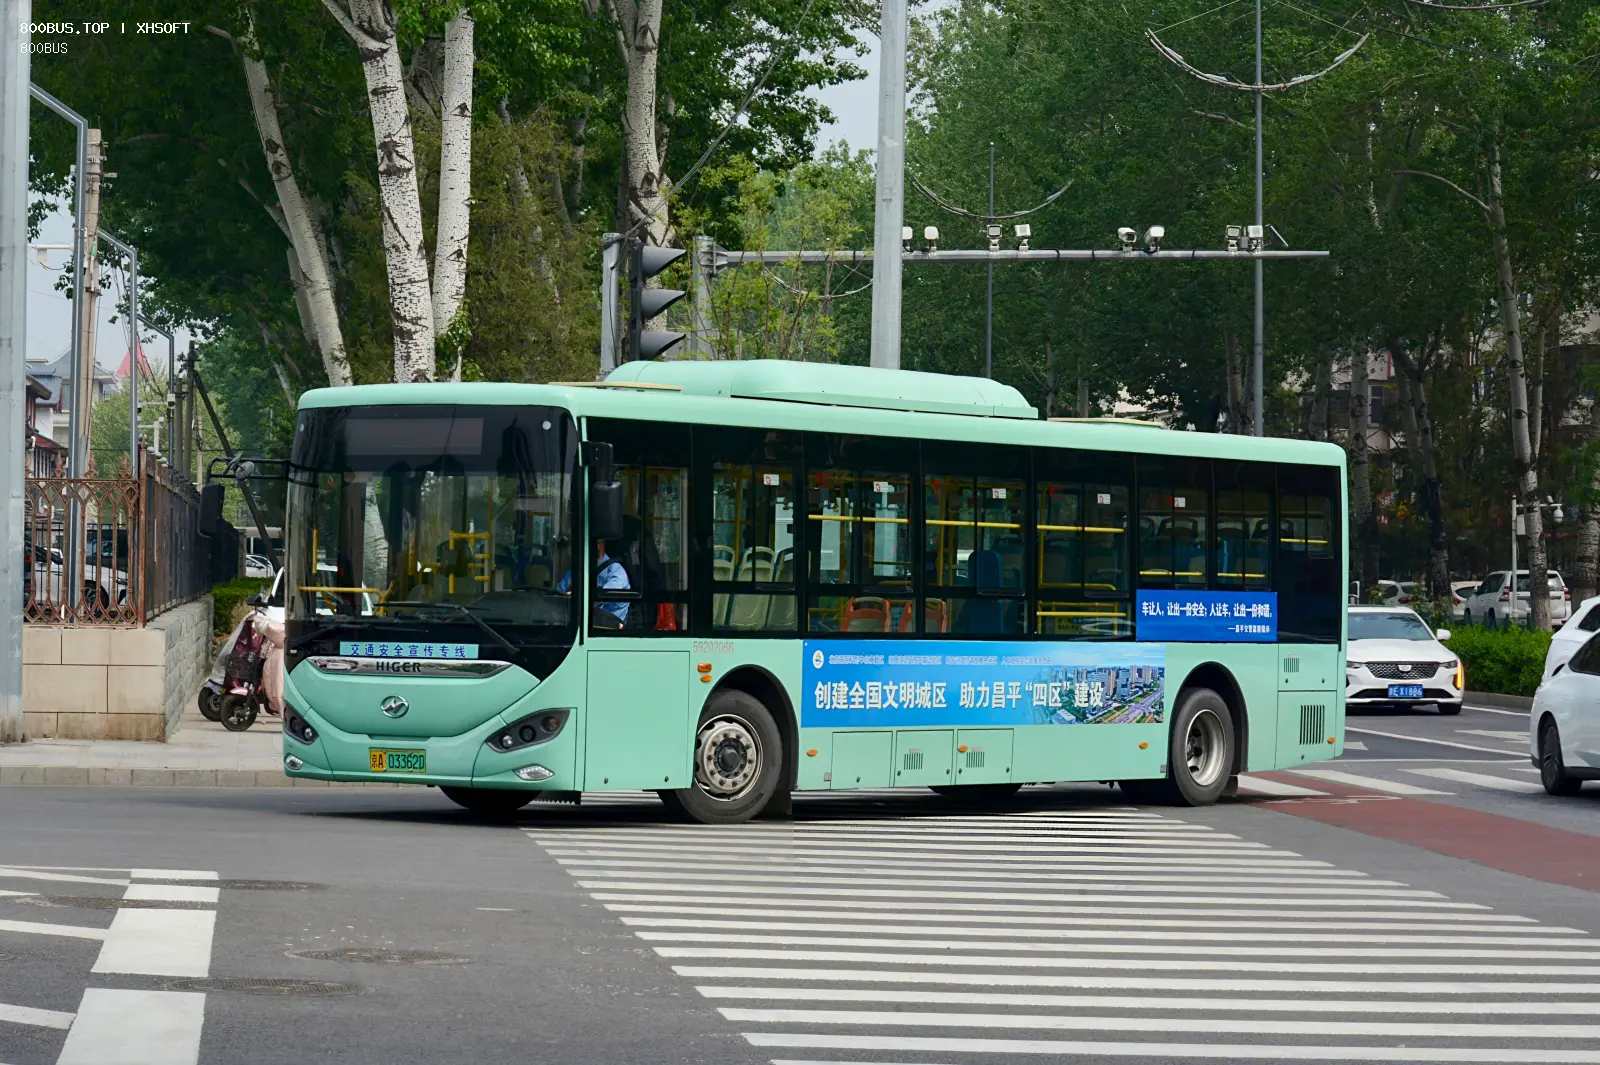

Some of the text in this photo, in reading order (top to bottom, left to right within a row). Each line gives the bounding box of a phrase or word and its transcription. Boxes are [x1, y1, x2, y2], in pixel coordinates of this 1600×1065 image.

[350, 643, 466, 658] 交通安全宣传专线
[376, 661, 421, 673] HIGER
[814, 680, 1104, 710] 创建全国文明城区 助力昌平“四区”建设
